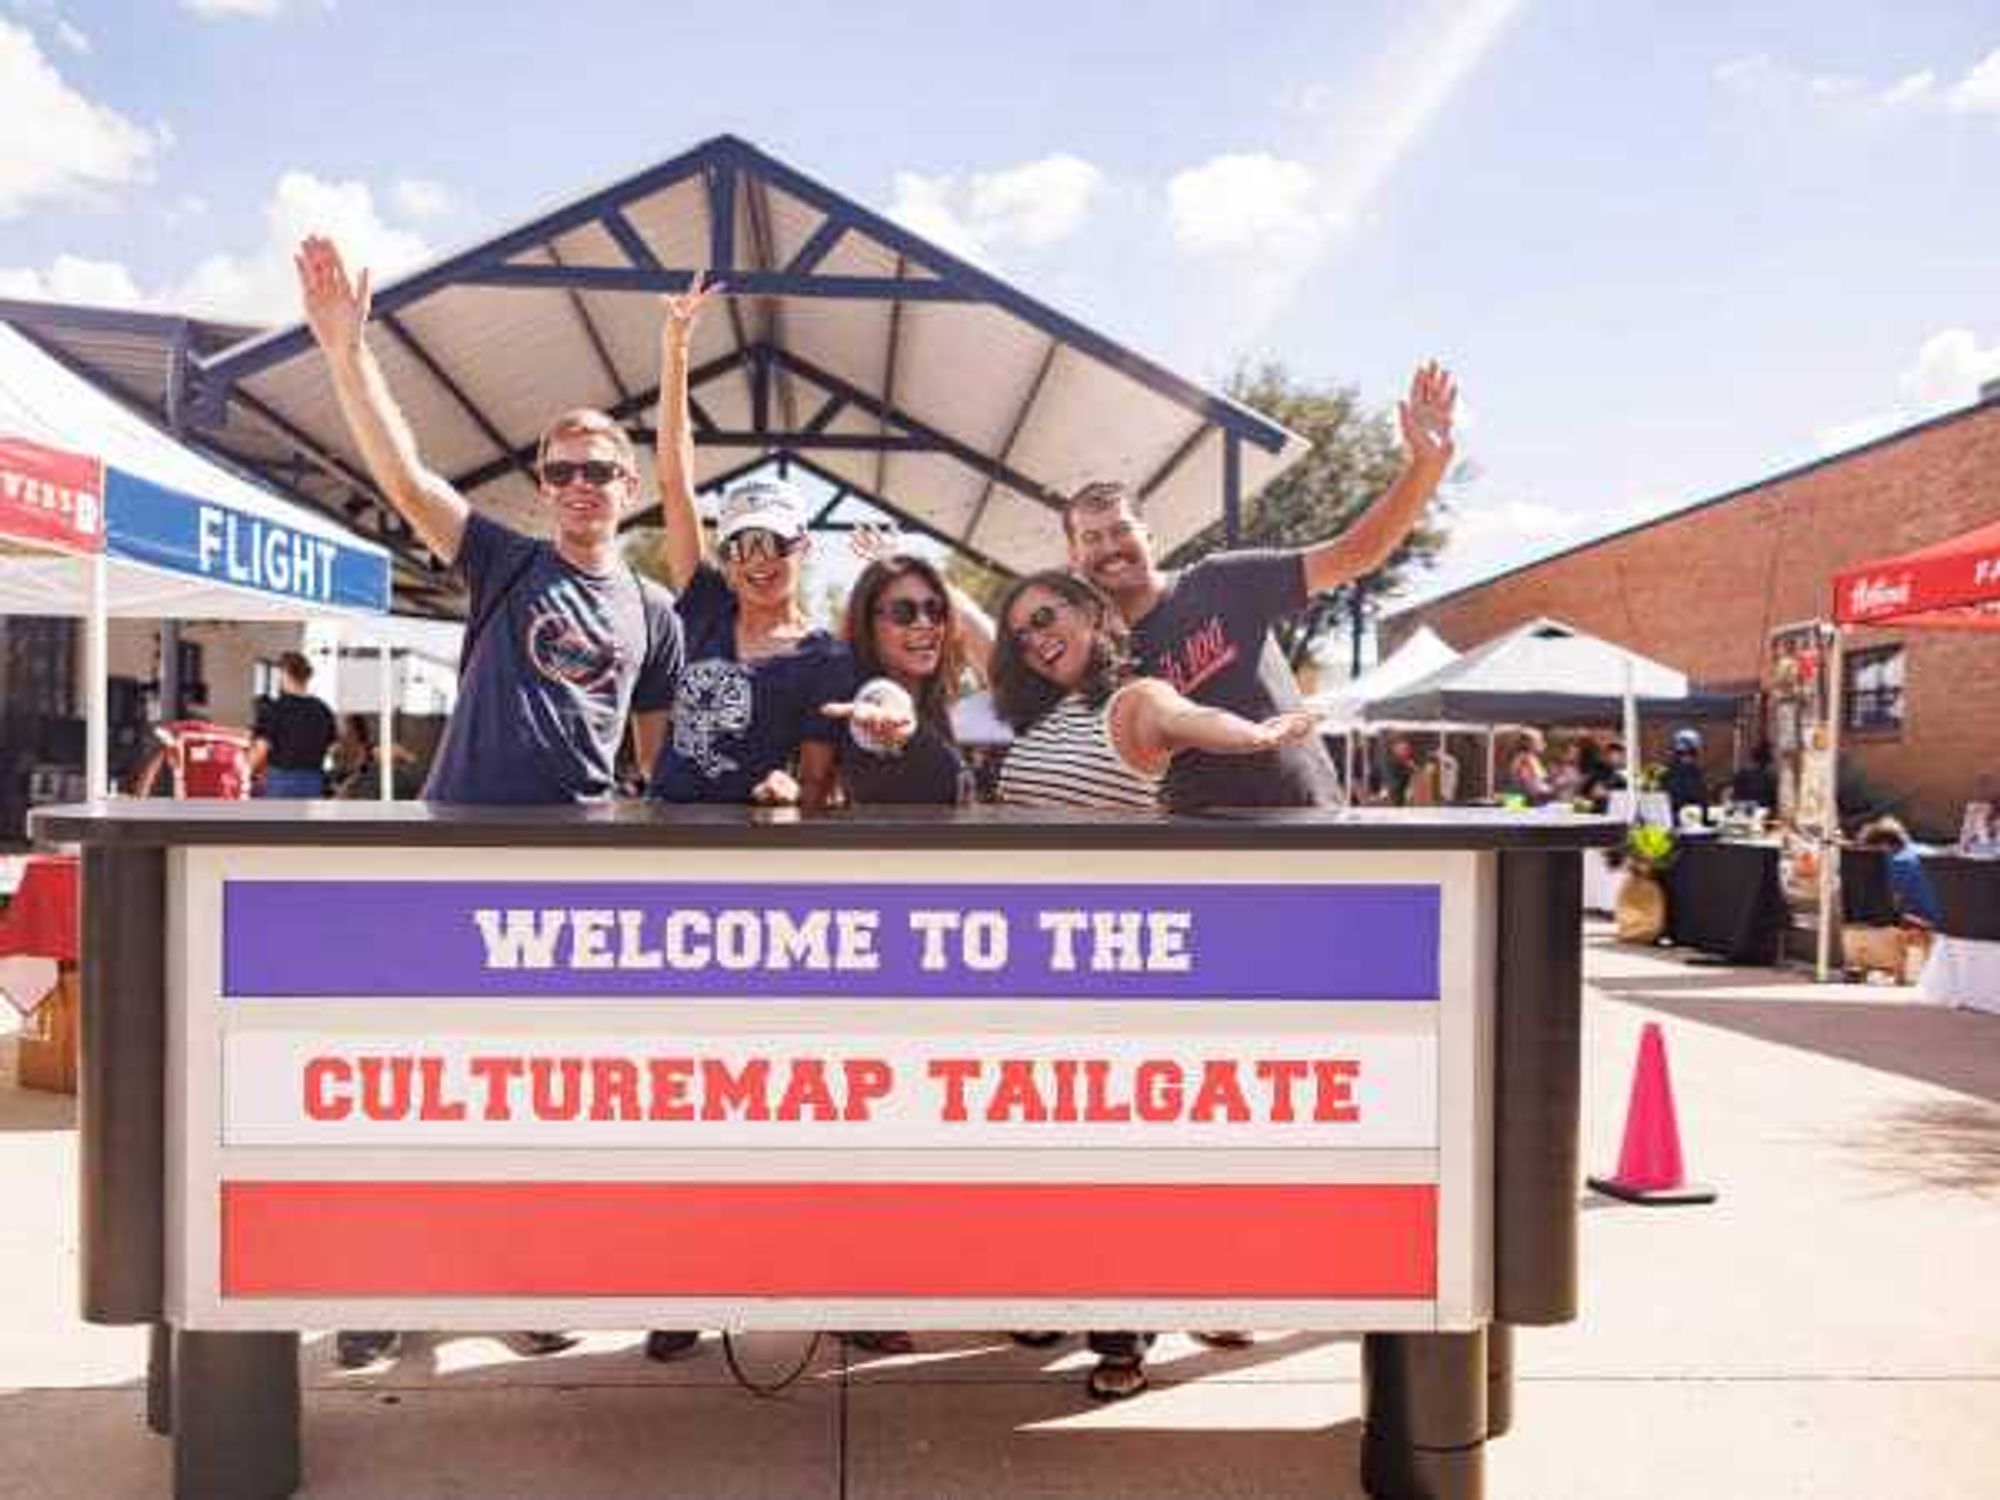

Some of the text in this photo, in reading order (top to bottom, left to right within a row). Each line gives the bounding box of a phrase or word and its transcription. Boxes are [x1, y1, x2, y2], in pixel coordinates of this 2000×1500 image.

[199, 505, 338, 603] FLIGHT
[474, 909, 1193, 973] WELCOME TO THE
[303, 1057, 1361, 1123] CULTUREMAP TAILGATE
